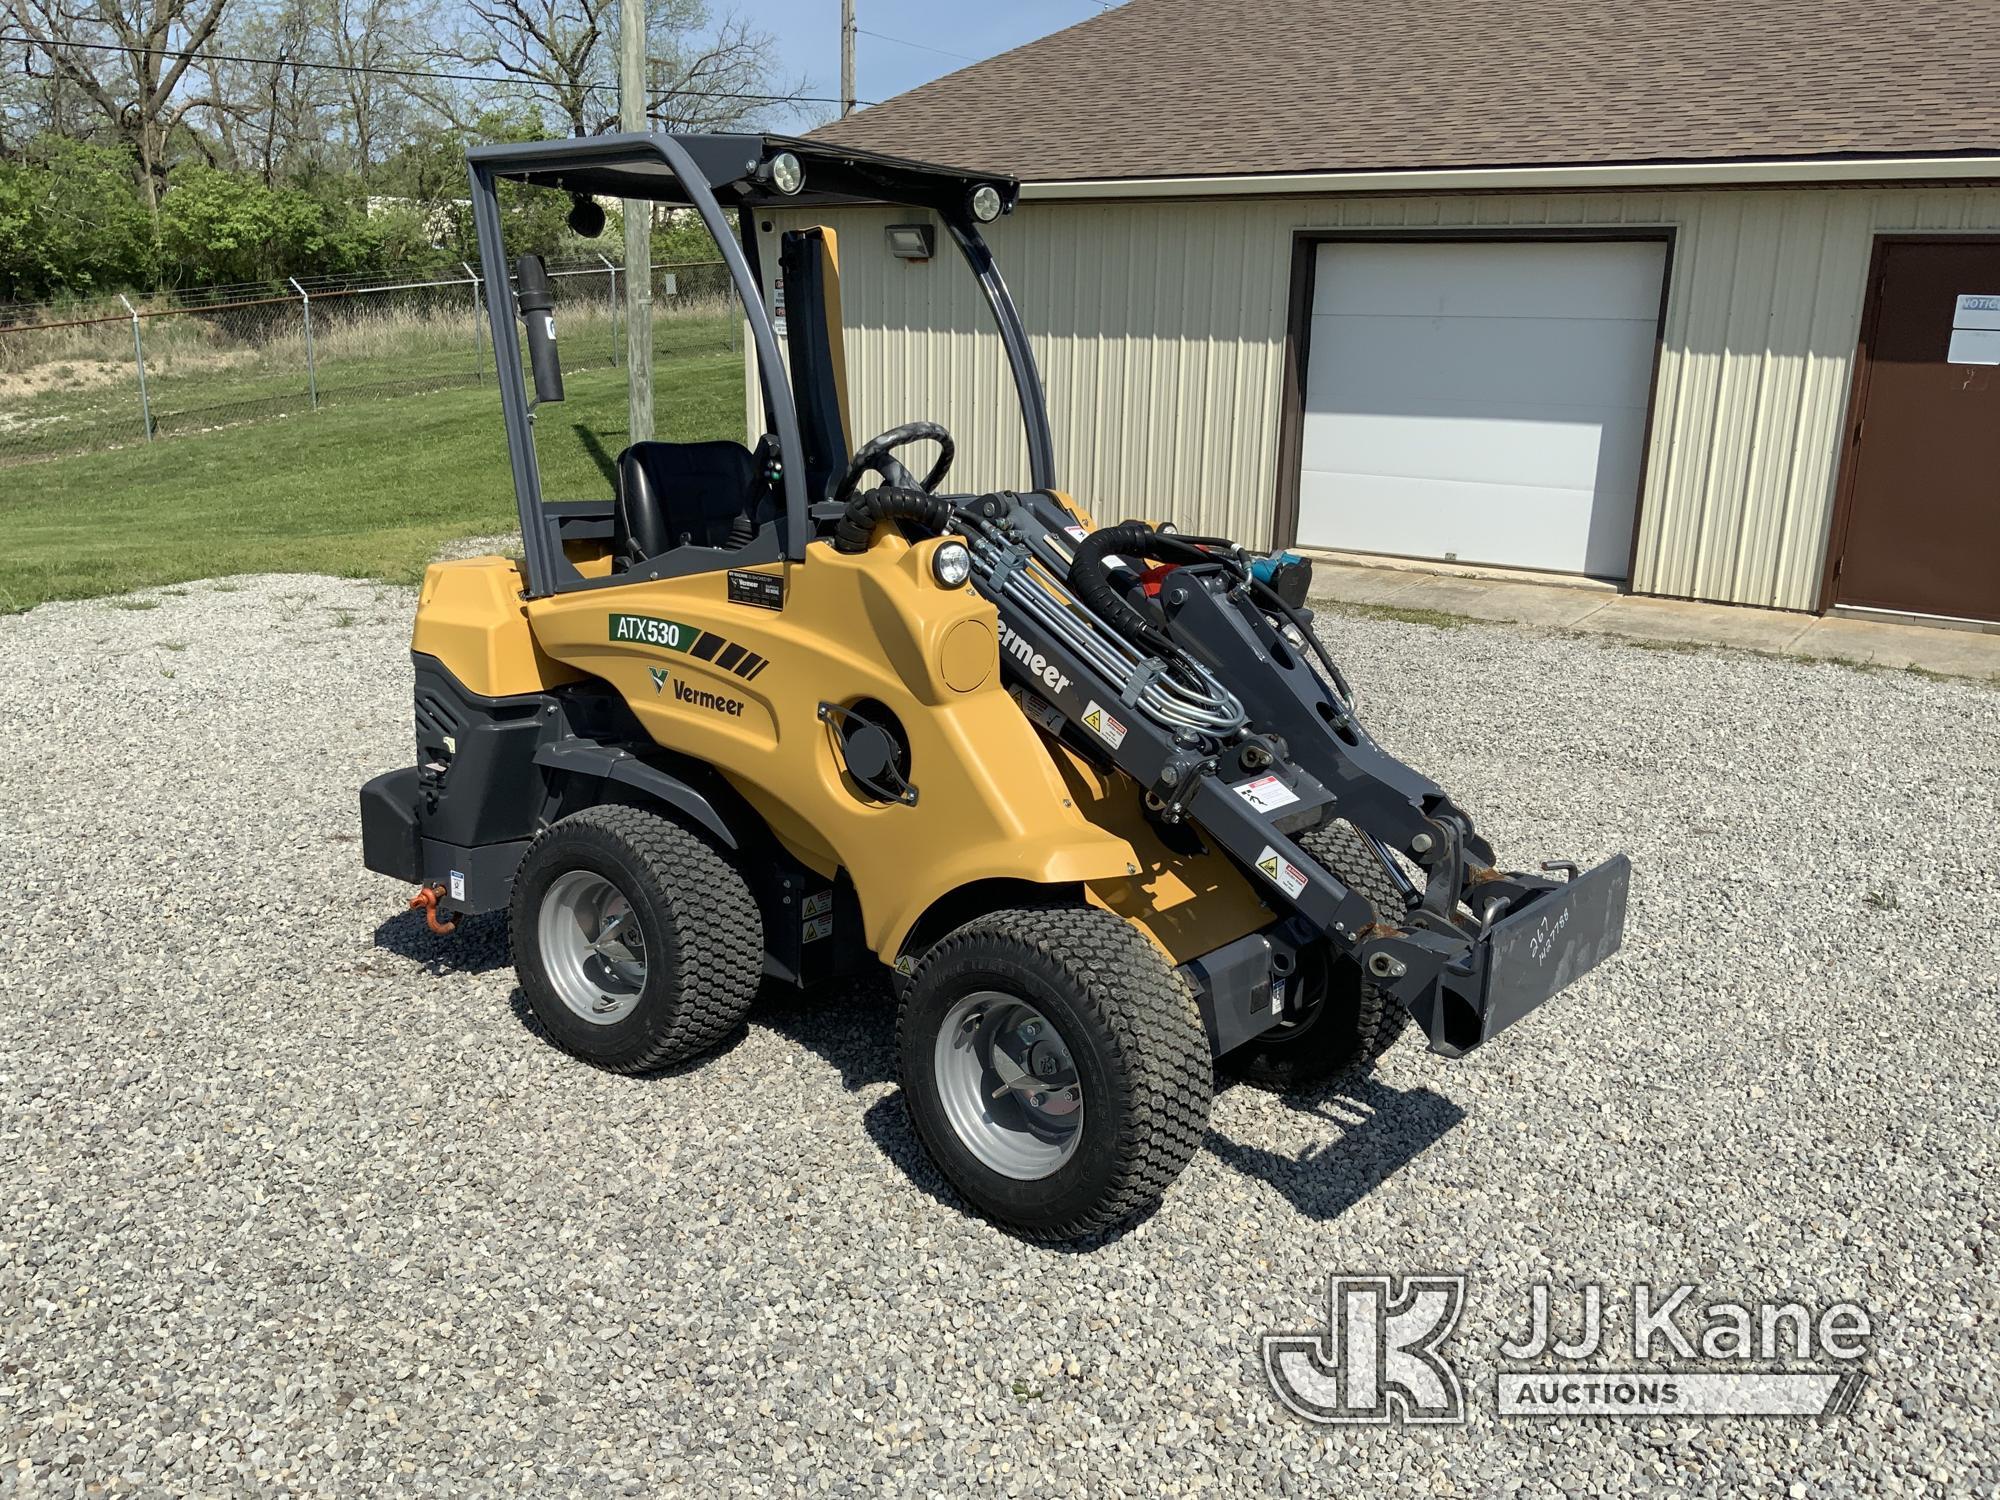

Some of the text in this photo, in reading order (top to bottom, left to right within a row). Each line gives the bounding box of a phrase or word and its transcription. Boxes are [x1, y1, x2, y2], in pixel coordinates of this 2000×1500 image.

[1960, 298, 2000, 310] NOTIC
[617, 616, 680, 647] ATX530
[997, 609, 1070, 694] ermeer
[673, 678, 745, 717] Vermeer
